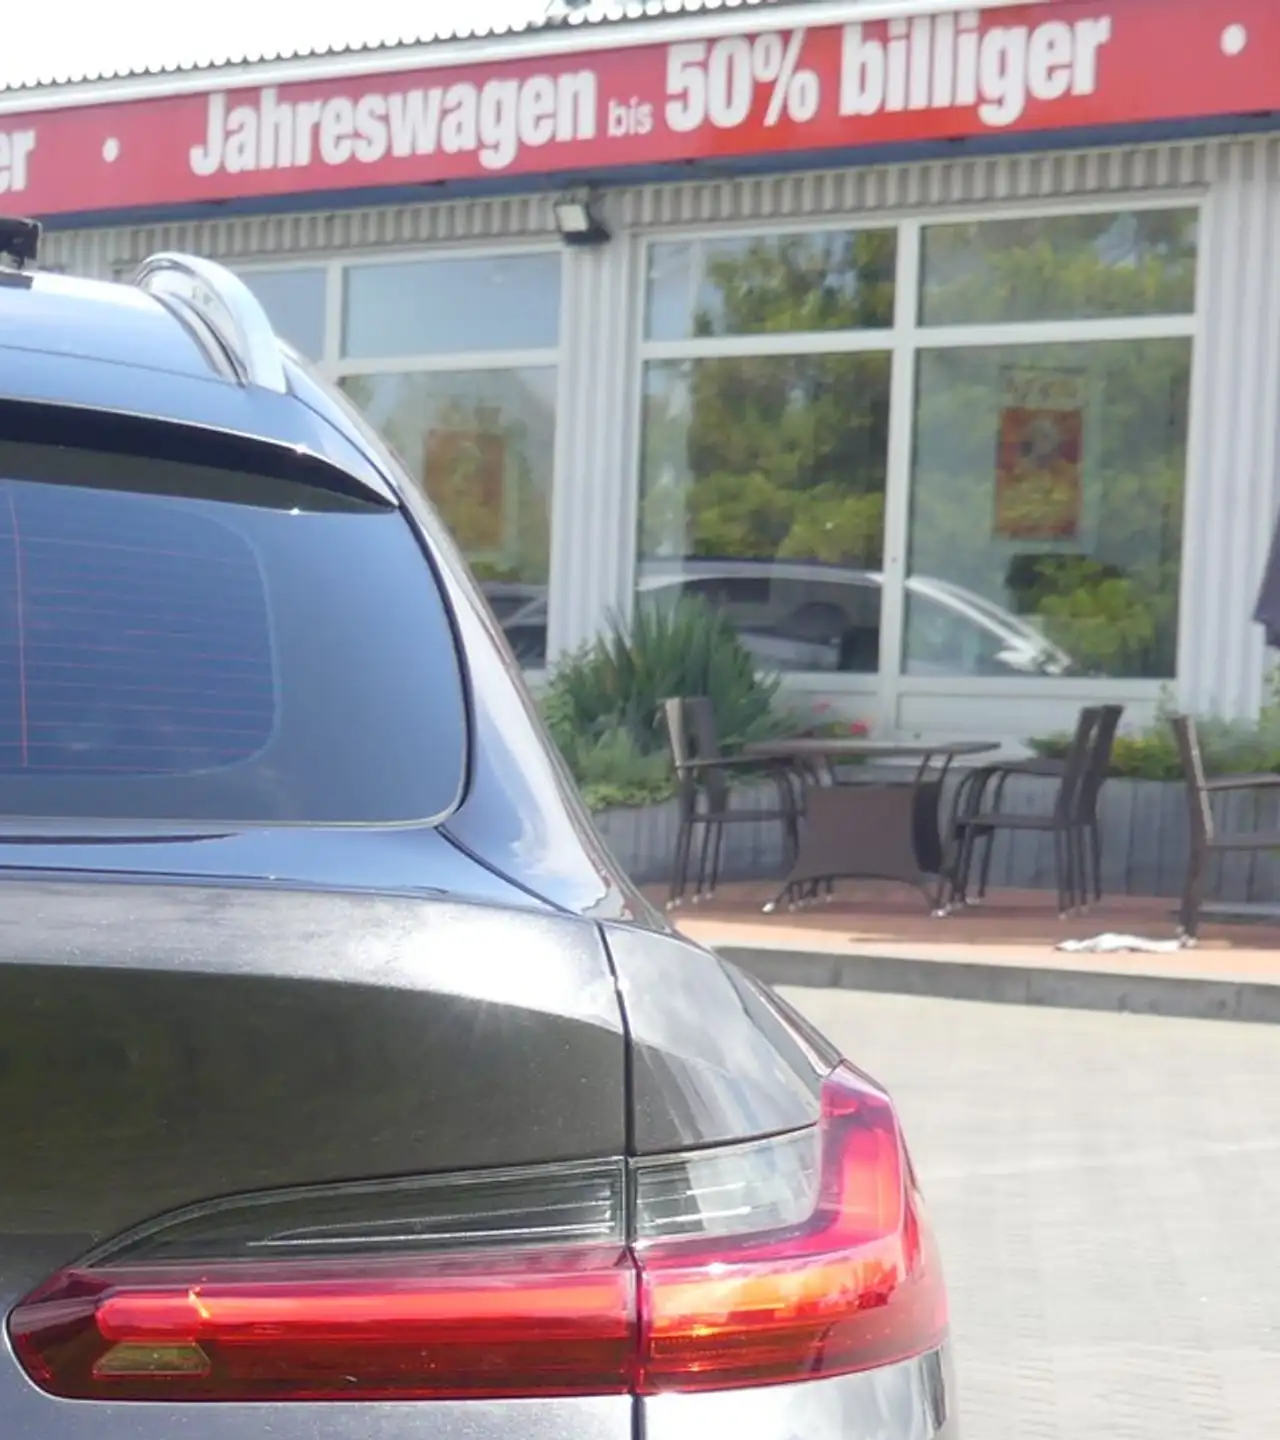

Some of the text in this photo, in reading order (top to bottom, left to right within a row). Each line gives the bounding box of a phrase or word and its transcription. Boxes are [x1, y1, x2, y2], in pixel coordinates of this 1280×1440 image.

[189, 68, 599, 177] Jahreswagen
[606, 95, 654, 138] bis
[664, 27, 820, 132] 50%
[839, 11, 1111, 127] billiger
